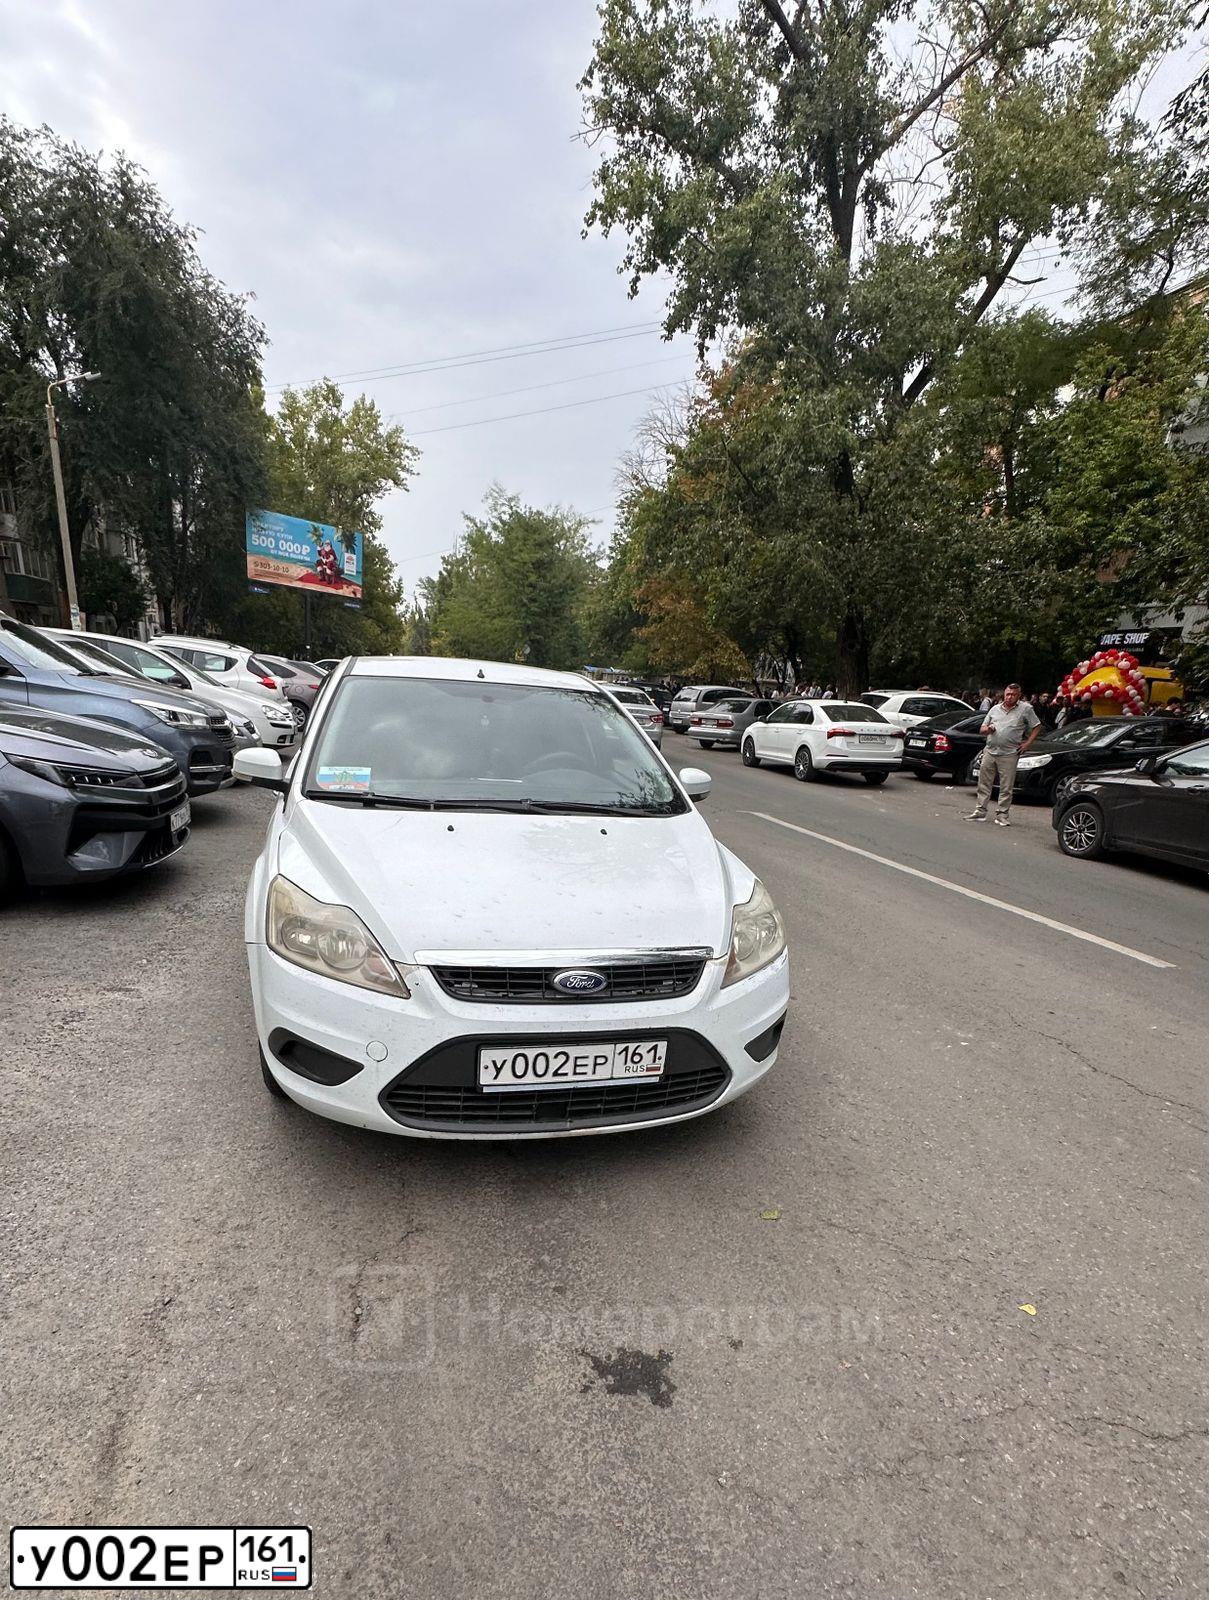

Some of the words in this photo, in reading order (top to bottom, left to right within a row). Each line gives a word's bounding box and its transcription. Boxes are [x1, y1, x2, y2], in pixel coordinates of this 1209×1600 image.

[251, 534, 276, 549] 500
[1123, 632, 1150, 645] SHOP
[566, 975, 595, 988] Ford
[491, 1051, 609, 1081] У002ЕР
[617, 1043, 659, 1066] 161
[624, 1065, 646, 1074] RUS
